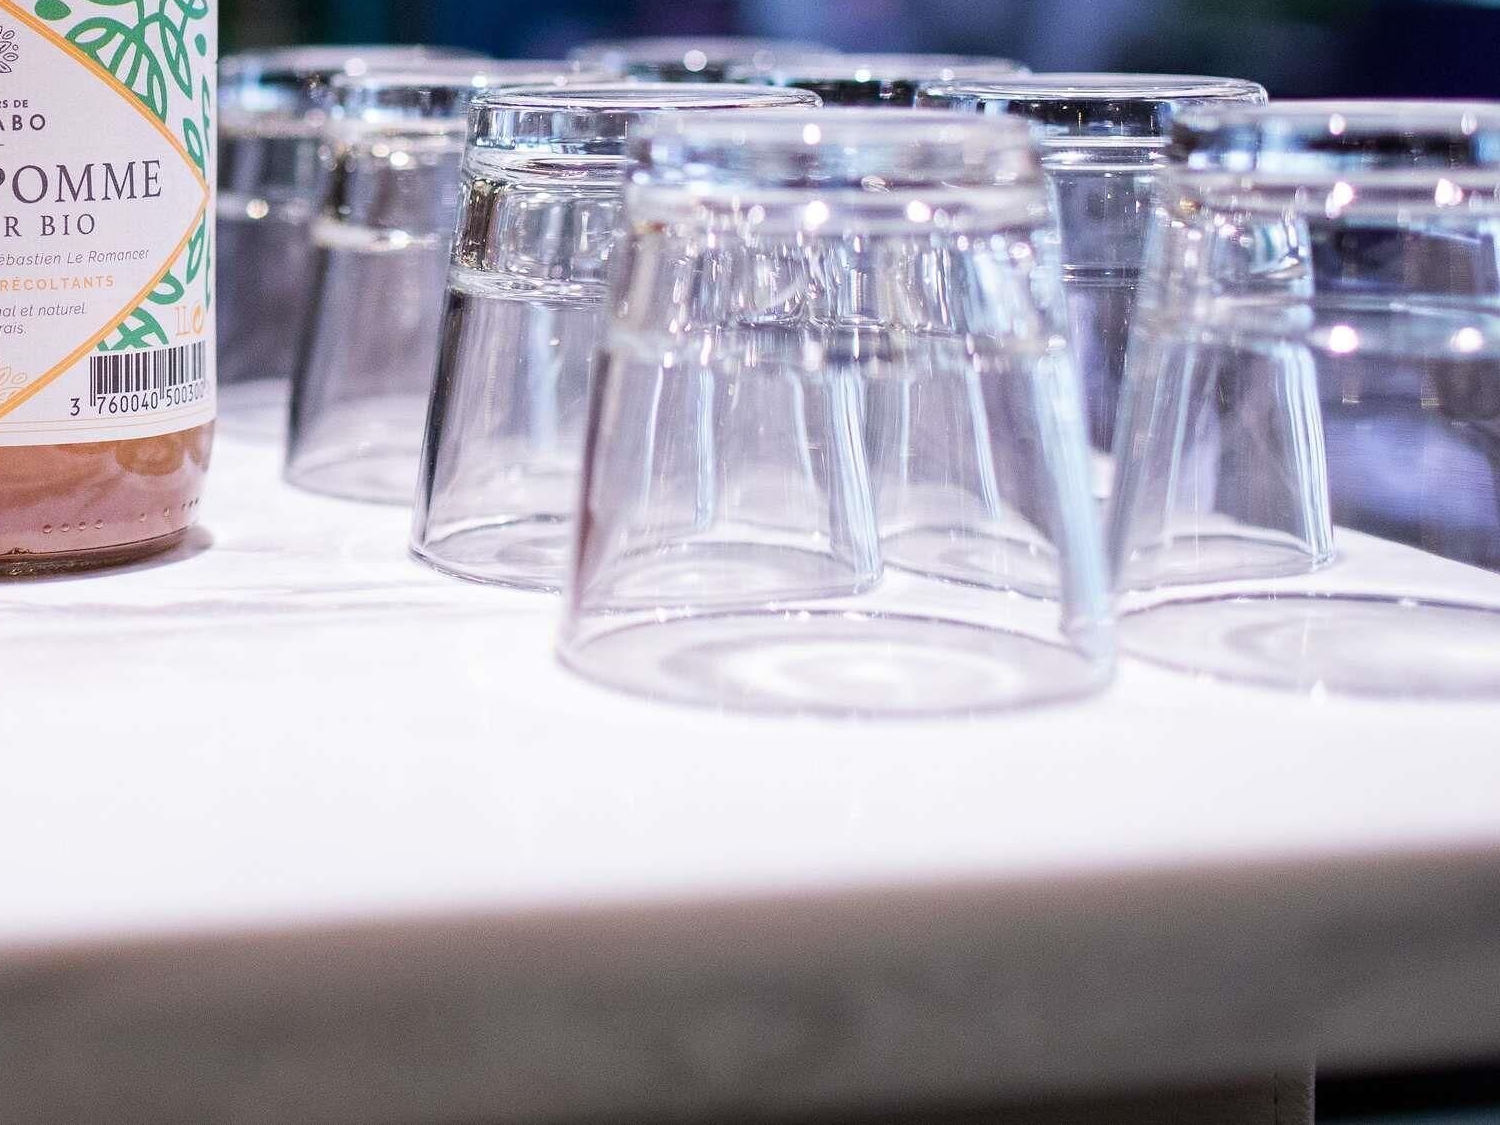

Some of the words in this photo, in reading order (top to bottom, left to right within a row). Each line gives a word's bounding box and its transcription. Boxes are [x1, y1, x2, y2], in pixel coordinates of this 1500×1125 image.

[13, 99, 29, 108] DE
[41, 213, 96, 236] BIO
[67, 252, 83, 263] Le
[88, 249, 149, 262] Romancer
[0, 275, 115, 291] RÉCOLTANTS
[20, 305, 33, 317] et
[70, 397, 80, 416] 3
[97, 391, 158, 414] 760040
